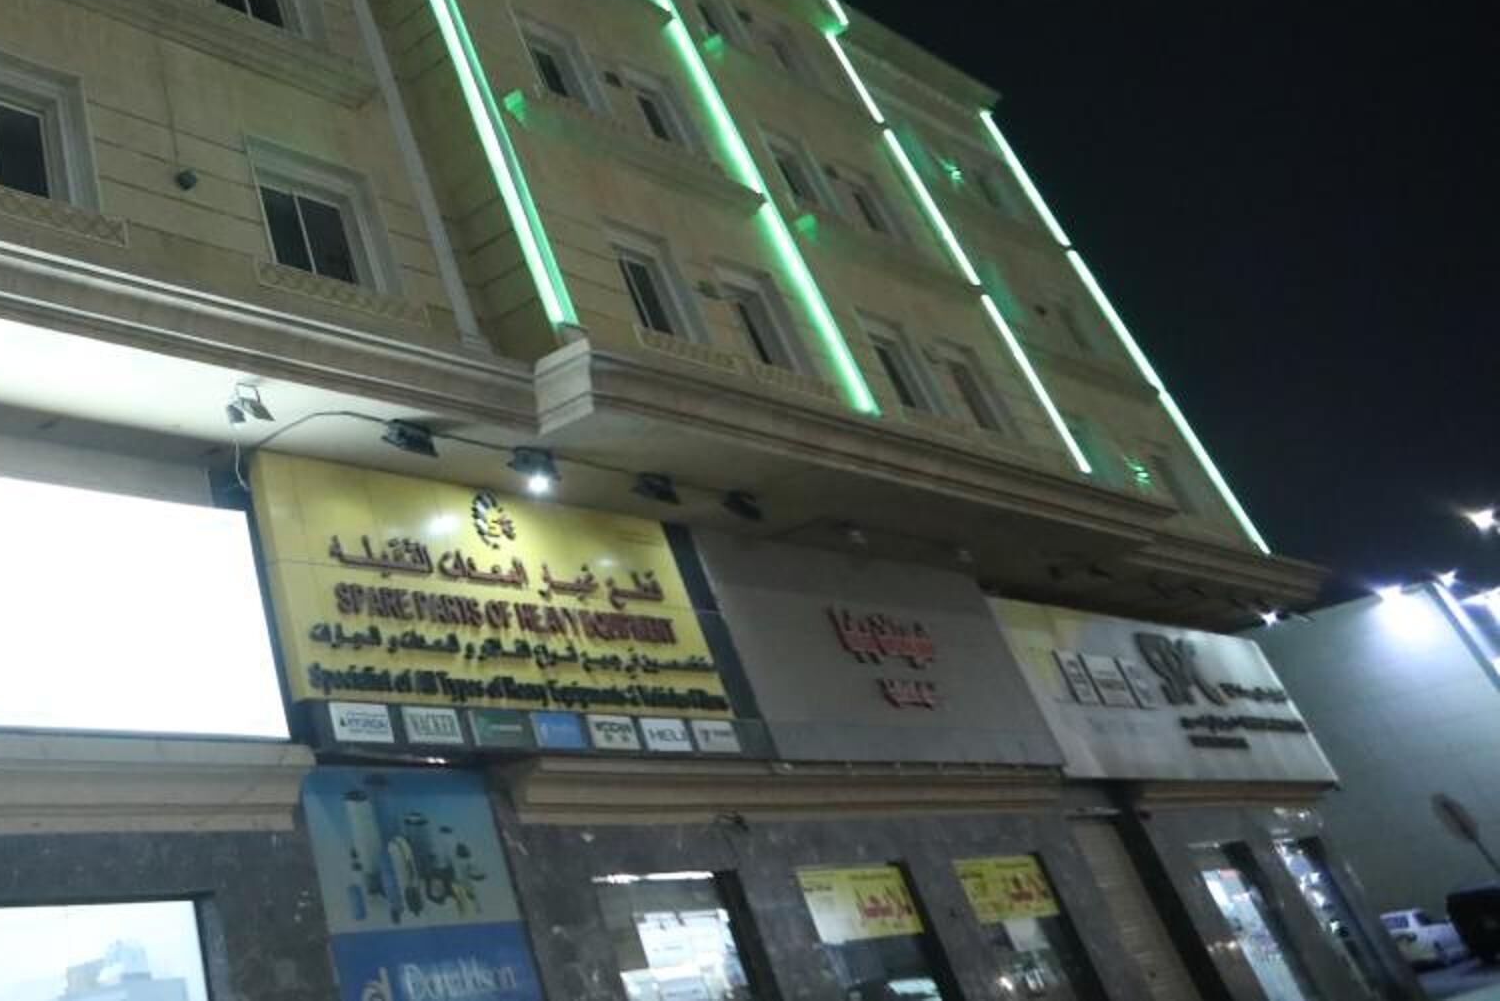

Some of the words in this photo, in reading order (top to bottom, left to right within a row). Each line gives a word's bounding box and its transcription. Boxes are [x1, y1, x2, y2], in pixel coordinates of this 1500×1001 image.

[329, 535, 434, 579] الثقيلة
[438, 548, 529, 589] المعدات
[334, 582, 415, 621] SPARE
[412, 590, 484, 628] PARTS
[484, 599, 512, 630] OF
[513, 602, 582, 640] HEAVY
[607, 569, 666, 611] قطع
